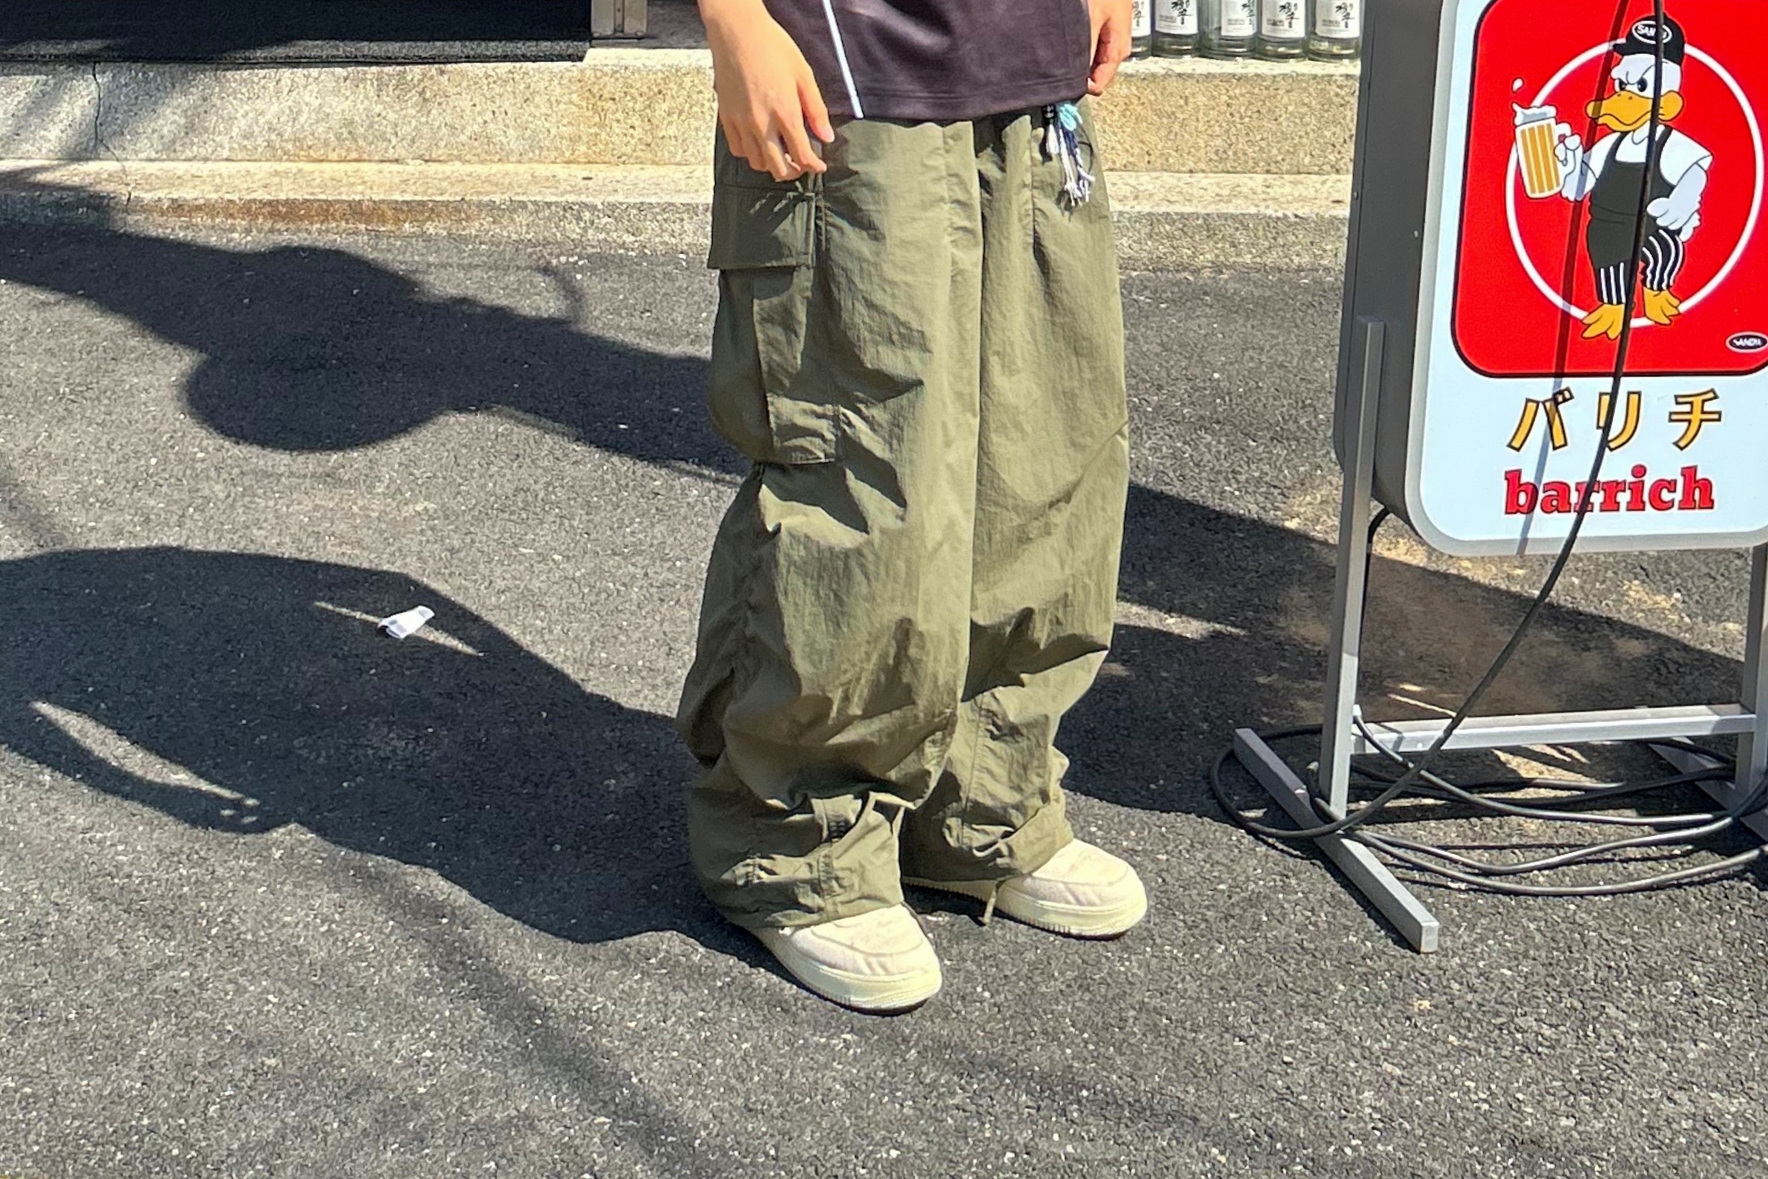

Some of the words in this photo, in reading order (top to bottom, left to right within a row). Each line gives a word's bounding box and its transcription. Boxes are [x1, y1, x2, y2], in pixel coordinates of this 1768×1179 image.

[1506, 386, 1722, 453] バリチ
[1504, 463, 1715, 516] barrich
